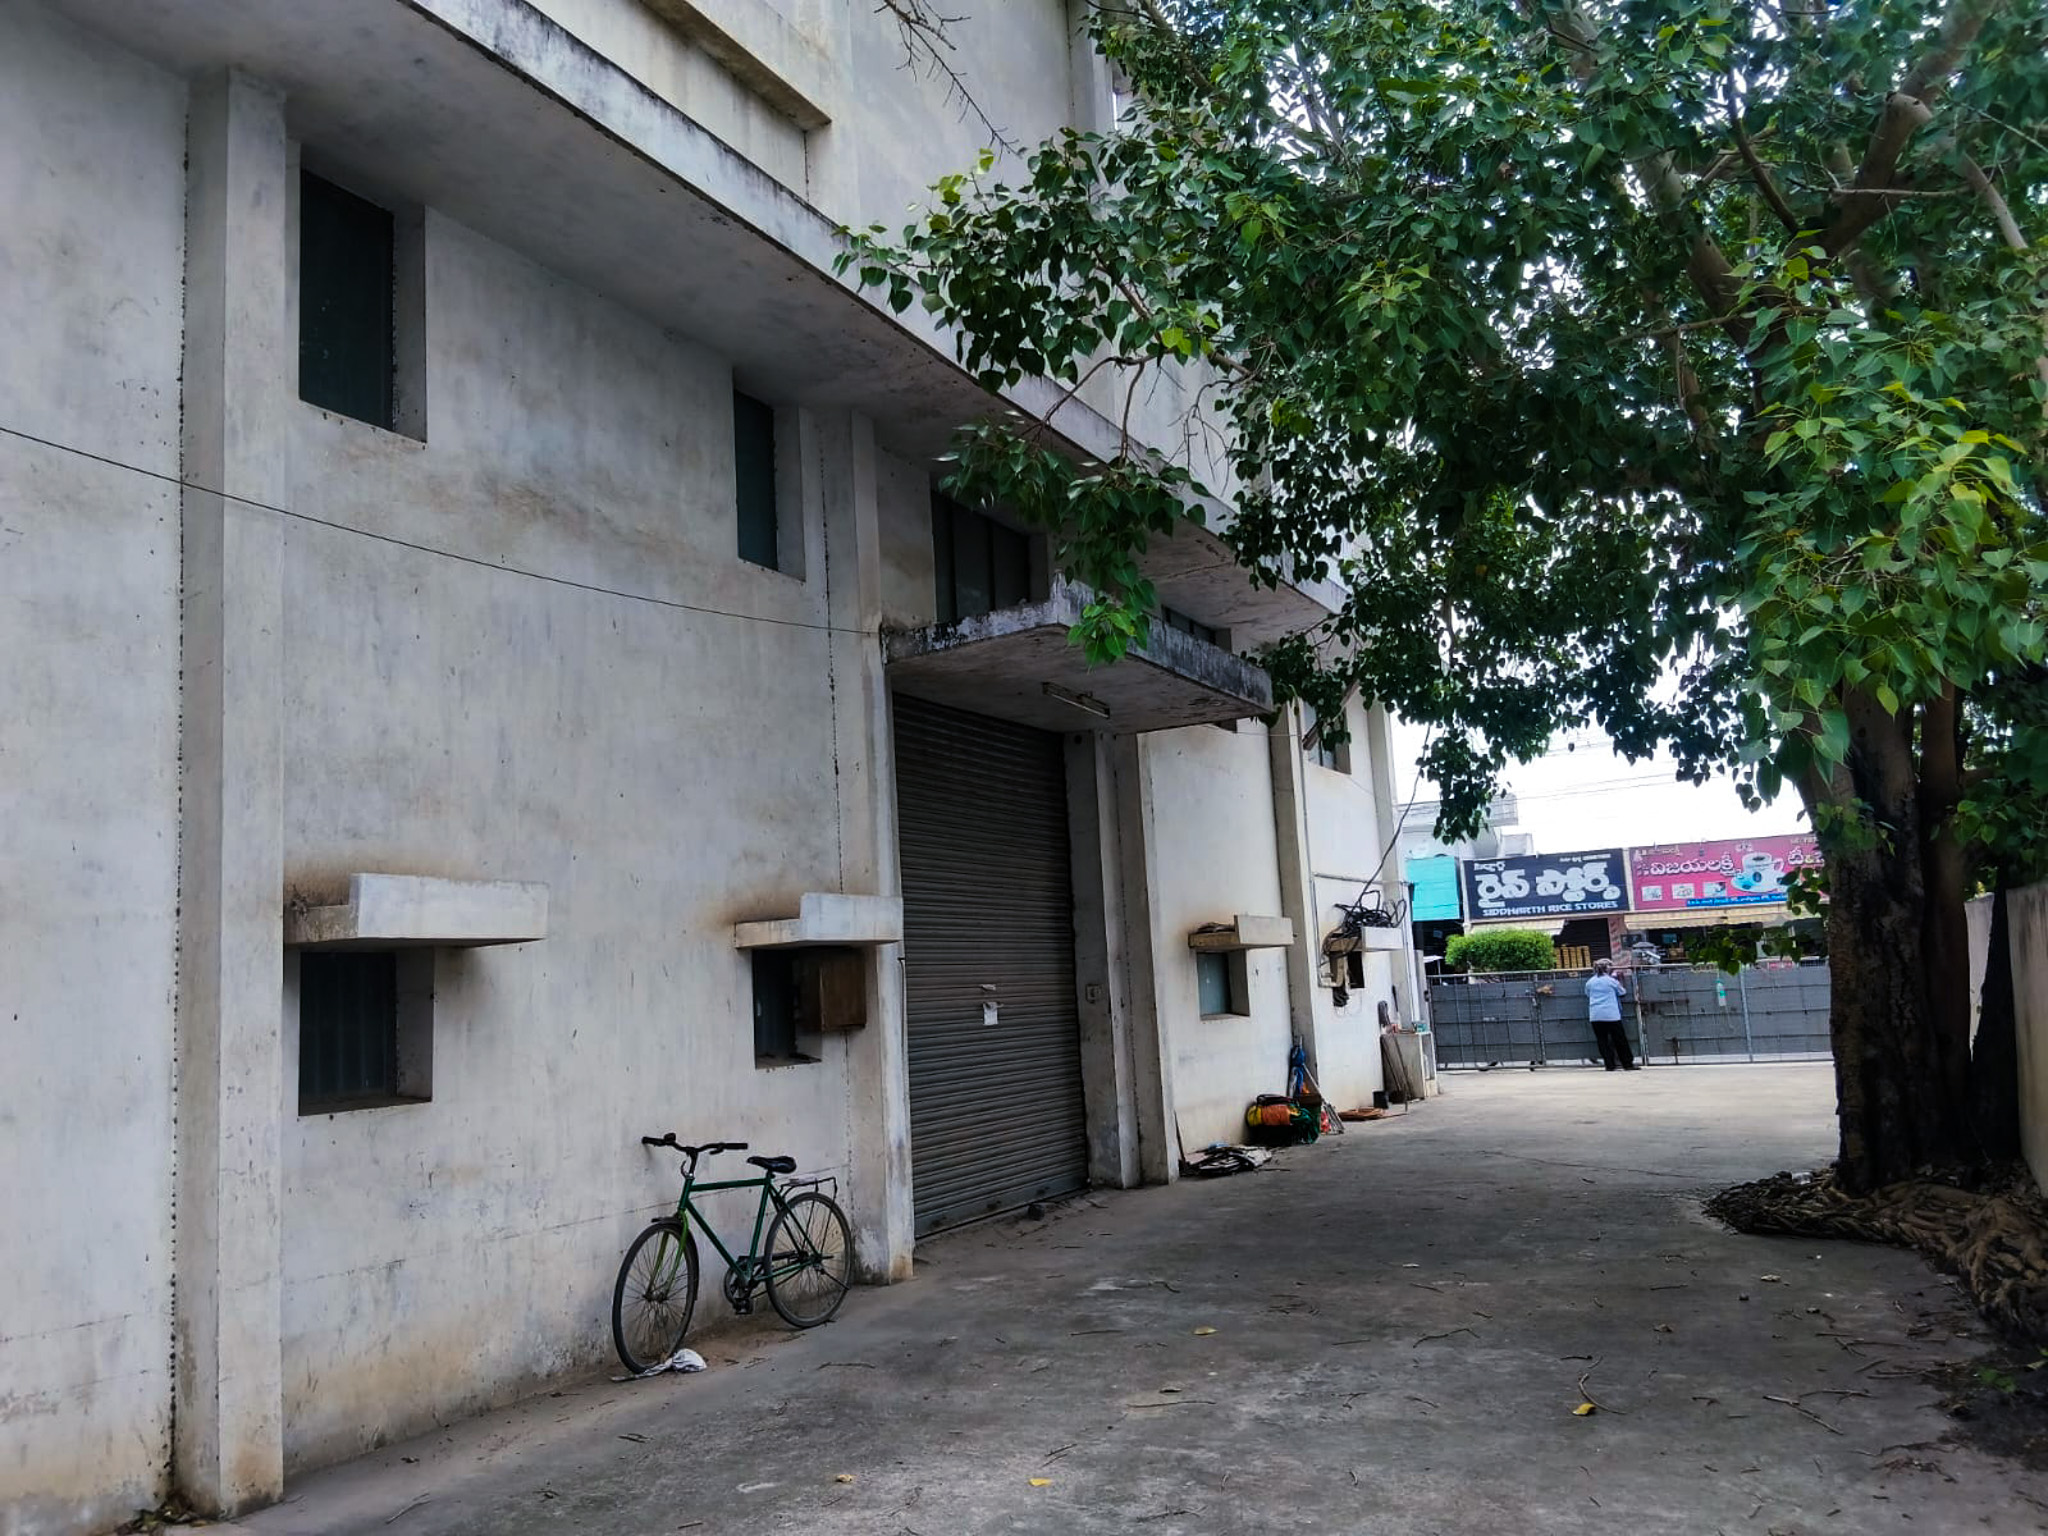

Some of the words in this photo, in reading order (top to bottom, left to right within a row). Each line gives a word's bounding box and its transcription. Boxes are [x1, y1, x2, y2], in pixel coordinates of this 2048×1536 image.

[1482, 905, 1546, 917] SIDDHARTH
[1548, 903, 1573, 912] RICE
[1575, 900, 1619, 911] STORES
